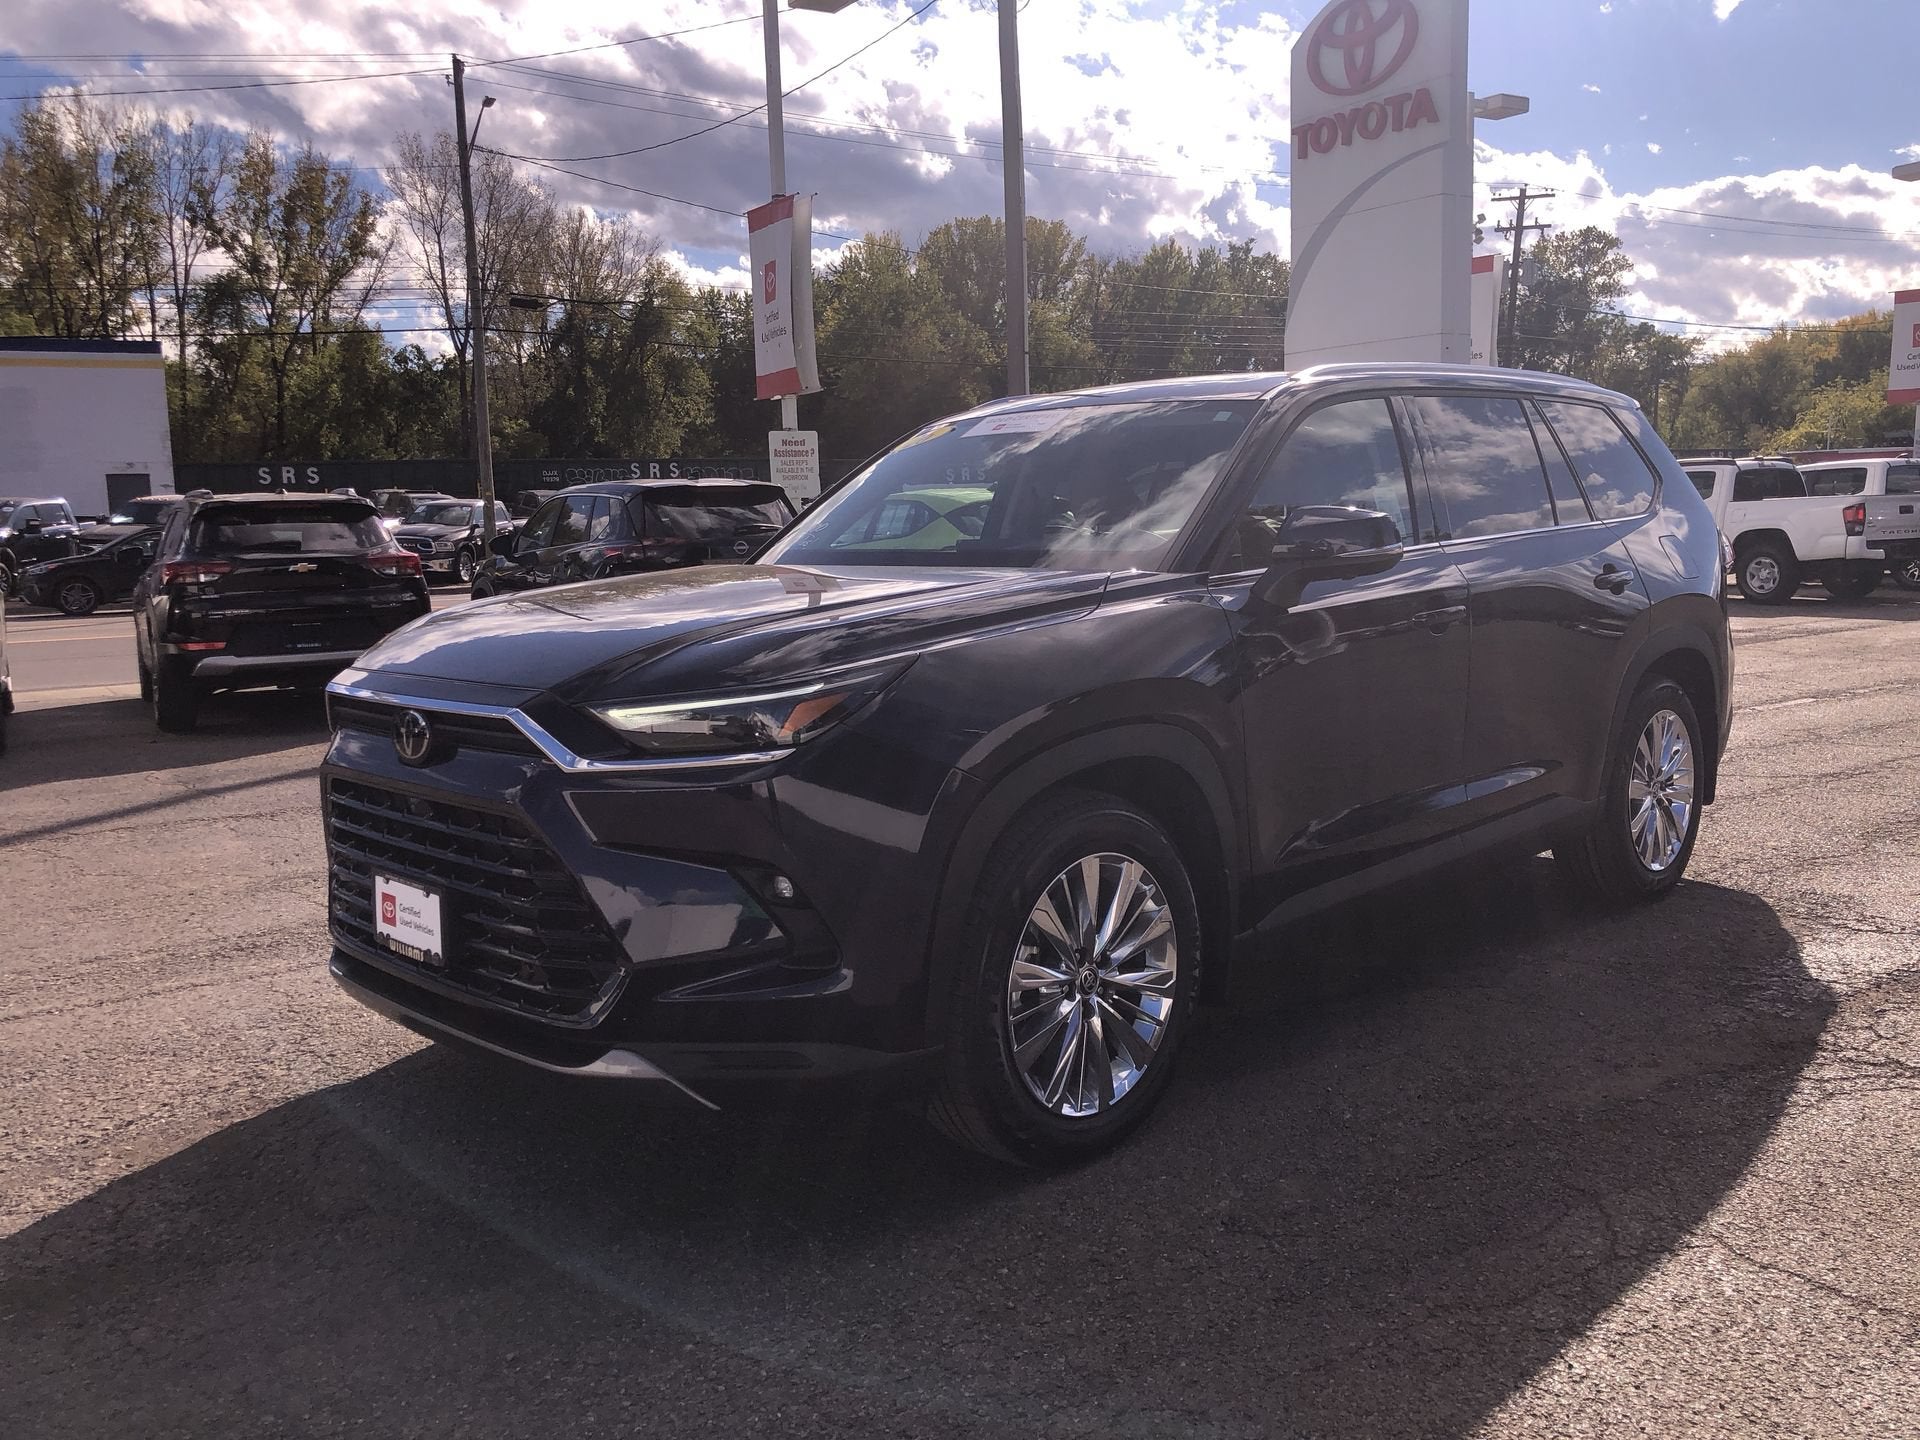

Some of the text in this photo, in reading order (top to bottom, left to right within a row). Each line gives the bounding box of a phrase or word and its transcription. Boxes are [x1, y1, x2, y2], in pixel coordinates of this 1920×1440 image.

[1291, 87, 1440, 160] TOYOTA
[781, 438, 806, 447] Need
[774, 448, 809, 458] Assistance
[399, 903, 422, 919] Certified
[399, 917, 435, 937] Used Vehicles
[389, 939, 424, 962] WILLIAMS
